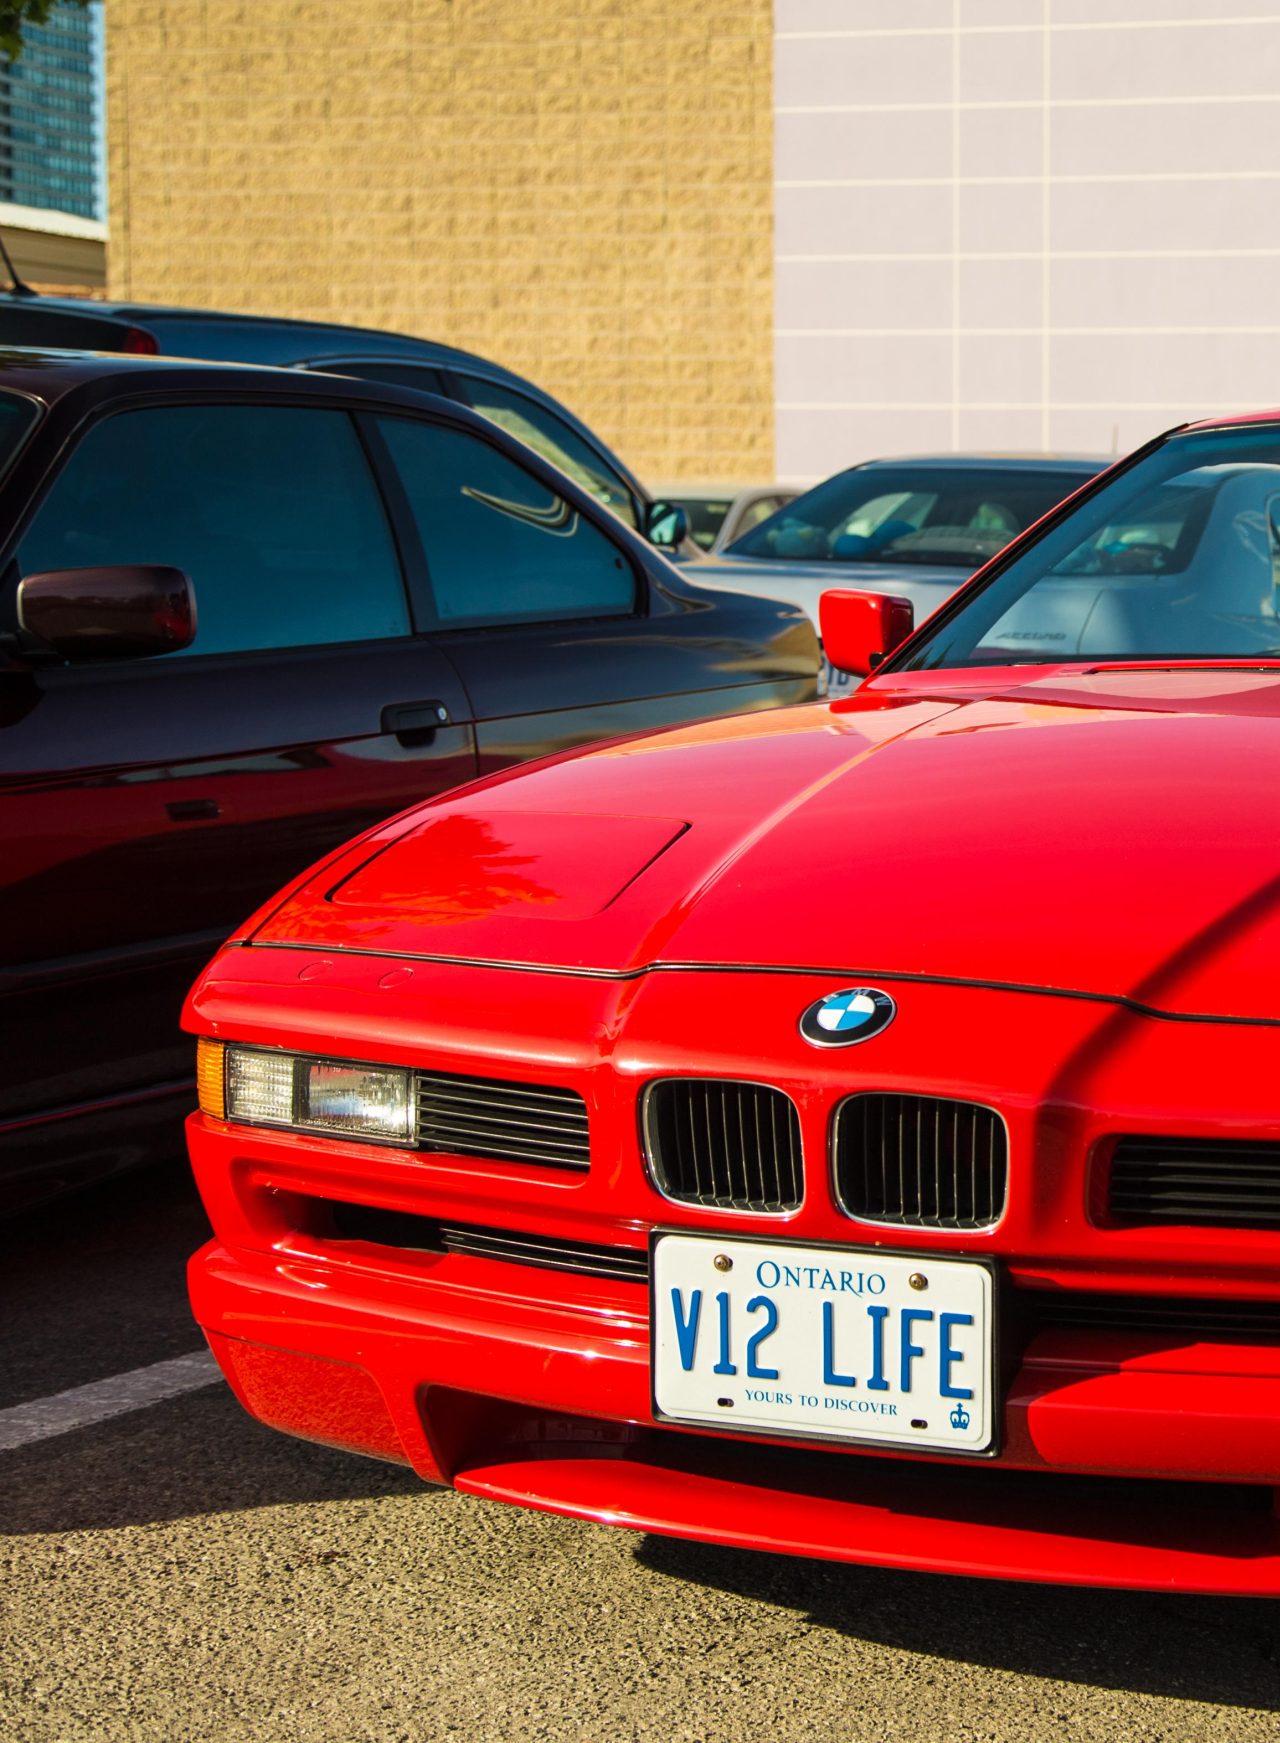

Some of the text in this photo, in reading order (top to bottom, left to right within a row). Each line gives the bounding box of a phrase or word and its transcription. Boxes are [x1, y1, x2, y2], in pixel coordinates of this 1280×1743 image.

[823, 989, 892, 1006] BMW
[756, 1260, 886, 1298] ONTARIO
[671, 1287, 974, 1400] V12 LIFE
[745, 1389, 897, 1416] YOURS TO DISCOVER
